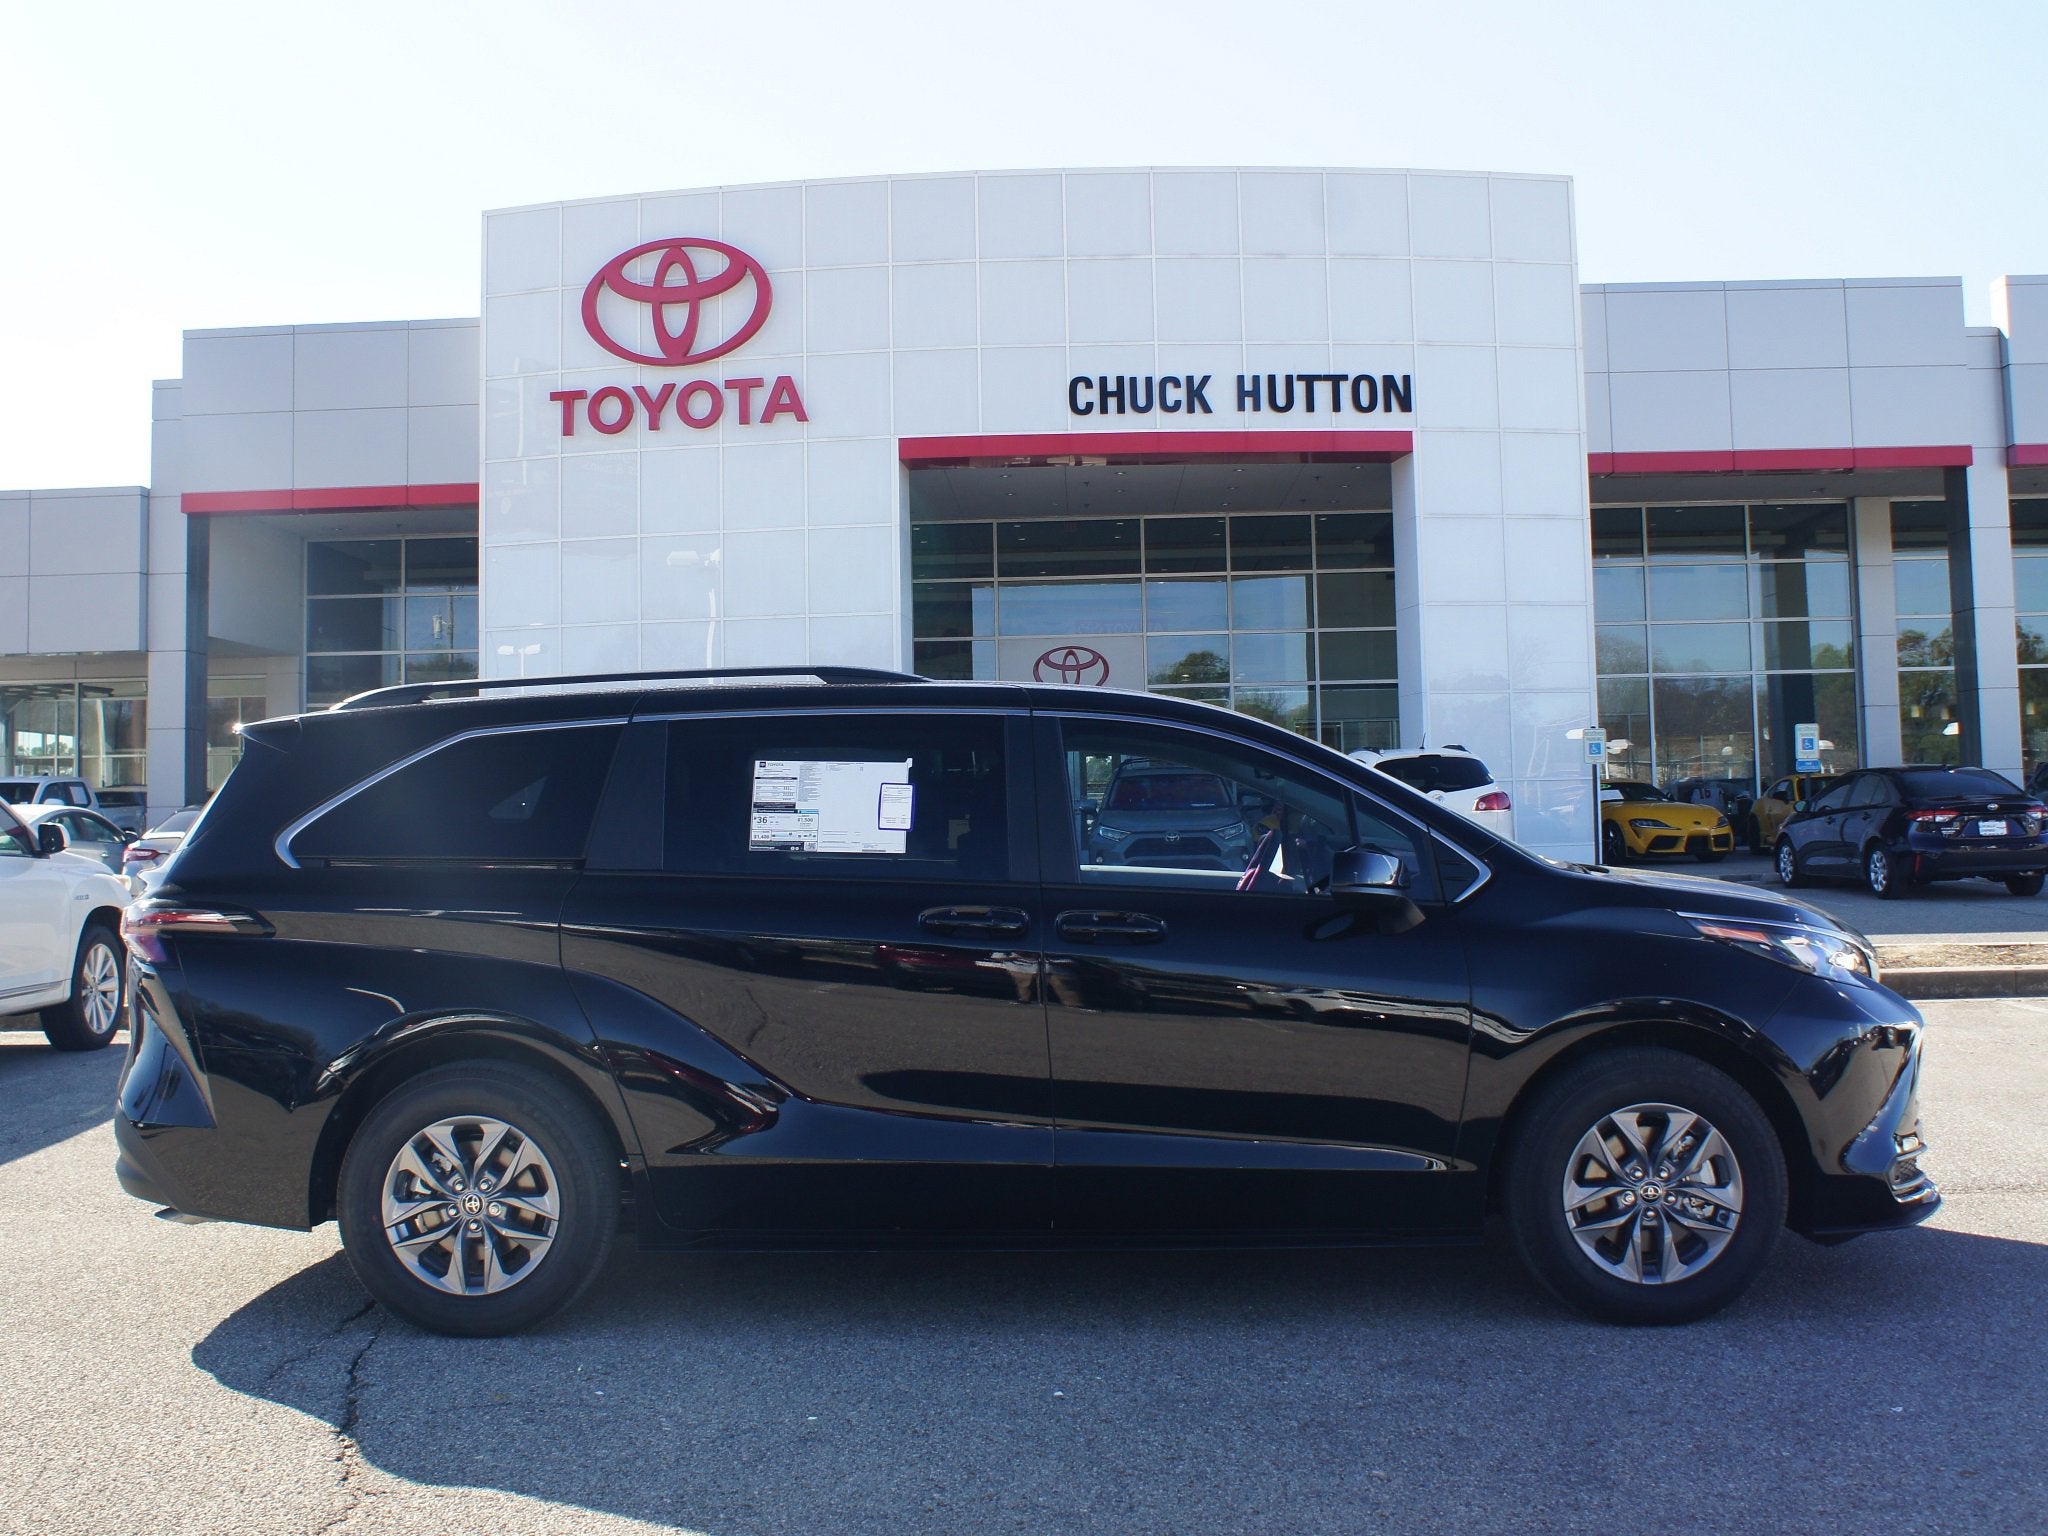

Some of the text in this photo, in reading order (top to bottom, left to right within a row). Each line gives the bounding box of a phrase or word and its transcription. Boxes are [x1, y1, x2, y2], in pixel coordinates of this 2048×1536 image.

[549, 375, 809, 437] TOYOTA
[1068, 373, 1413, 416] CHUCK HUTTON
[756, 816, 768, 824] 36
